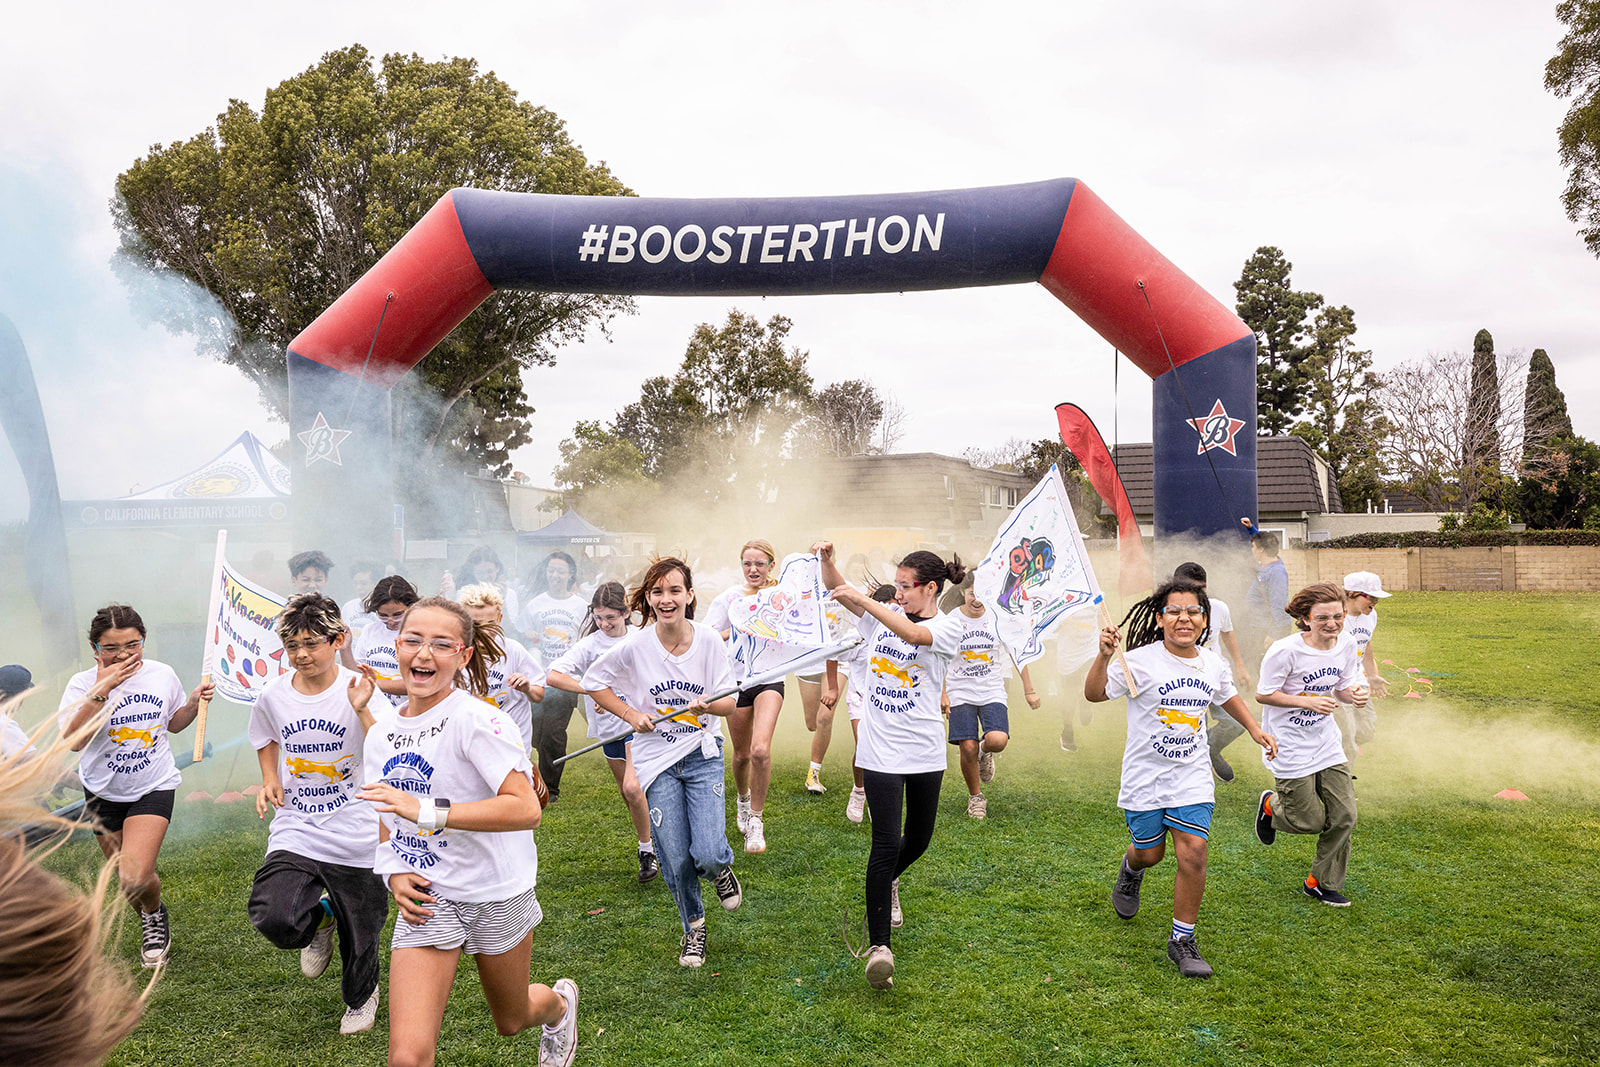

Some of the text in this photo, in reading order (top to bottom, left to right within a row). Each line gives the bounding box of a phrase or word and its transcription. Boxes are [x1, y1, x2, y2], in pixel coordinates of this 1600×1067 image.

[578, 212, 945, 264] #BOOSTERTHON
[104, 504, 264, 521] CALIFORNIA ELEMENTARY SCHOOL
[366, 646, 397, 659] CALIFORN
[1302, 667, 1343, 684] CALIFORN
[650, 680, 704, 696] CALIFORNIA
[876, 686, 908, 698] COUGAR
[1158, 678, 1214, 697] CALIFORNIA
[870, 694, 896, 713] COLOR
[110, 711, 162, 726] ELEMENTARY
[281, 718, 347, 740] CALIFORNIA
[285, 740, 344, 754] ELEMENTARY
[1152, 742, 1182, 758] COLOR
[132, 758, 152, 773] RUN
[298, 785, 340, 798] COUGAR
[291, 792, 349, 813] COLOR RUN
